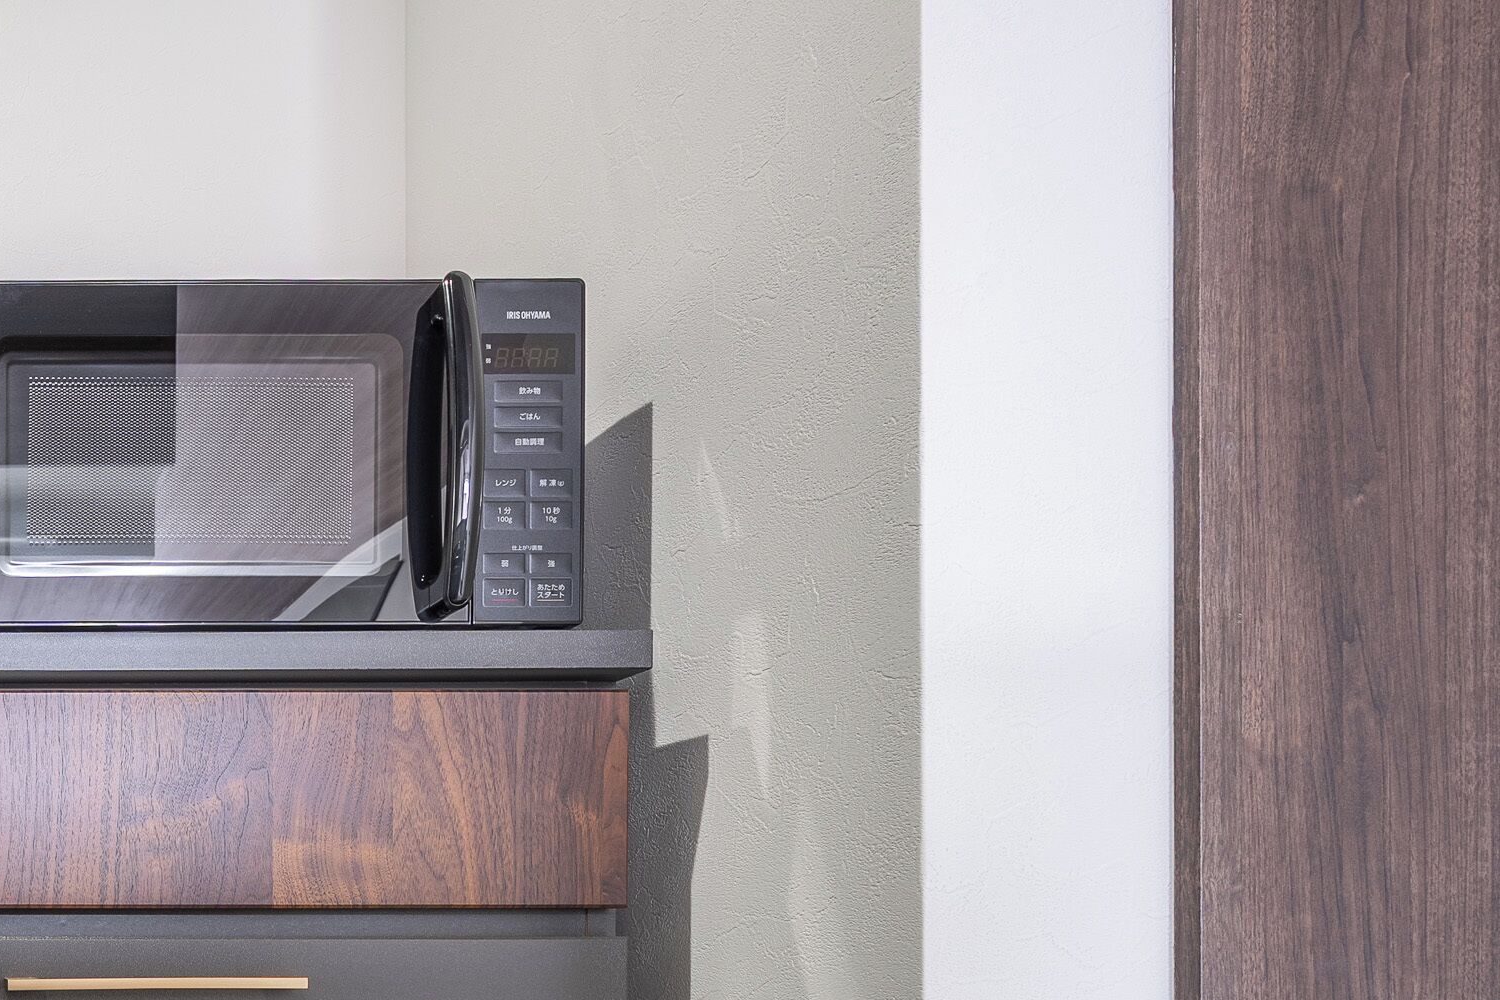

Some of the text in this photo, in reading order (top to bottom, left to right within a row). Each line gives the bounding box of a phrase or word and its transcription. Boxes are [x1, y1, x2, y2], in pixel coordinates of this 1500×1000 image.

[506, 311, 551, 319] IRIS OHYAMA
[518, 386, 541, 395] 飲み物
[519, 412, 541, 421] ごはん
[514, 437, 545, 446] 自動調理
[495, 478, 517, 487] レンジ
[496, 516, 513, 524] 100g
[545, 516, 558, 524] 10g
[500, 560, 509, 568] 弱
[547, 560, 556, 568] 強
[537, 583, 566, 591] あたため
[491, 588, 519, 596] とりけし
[537, 591, 565, 599] スタート
